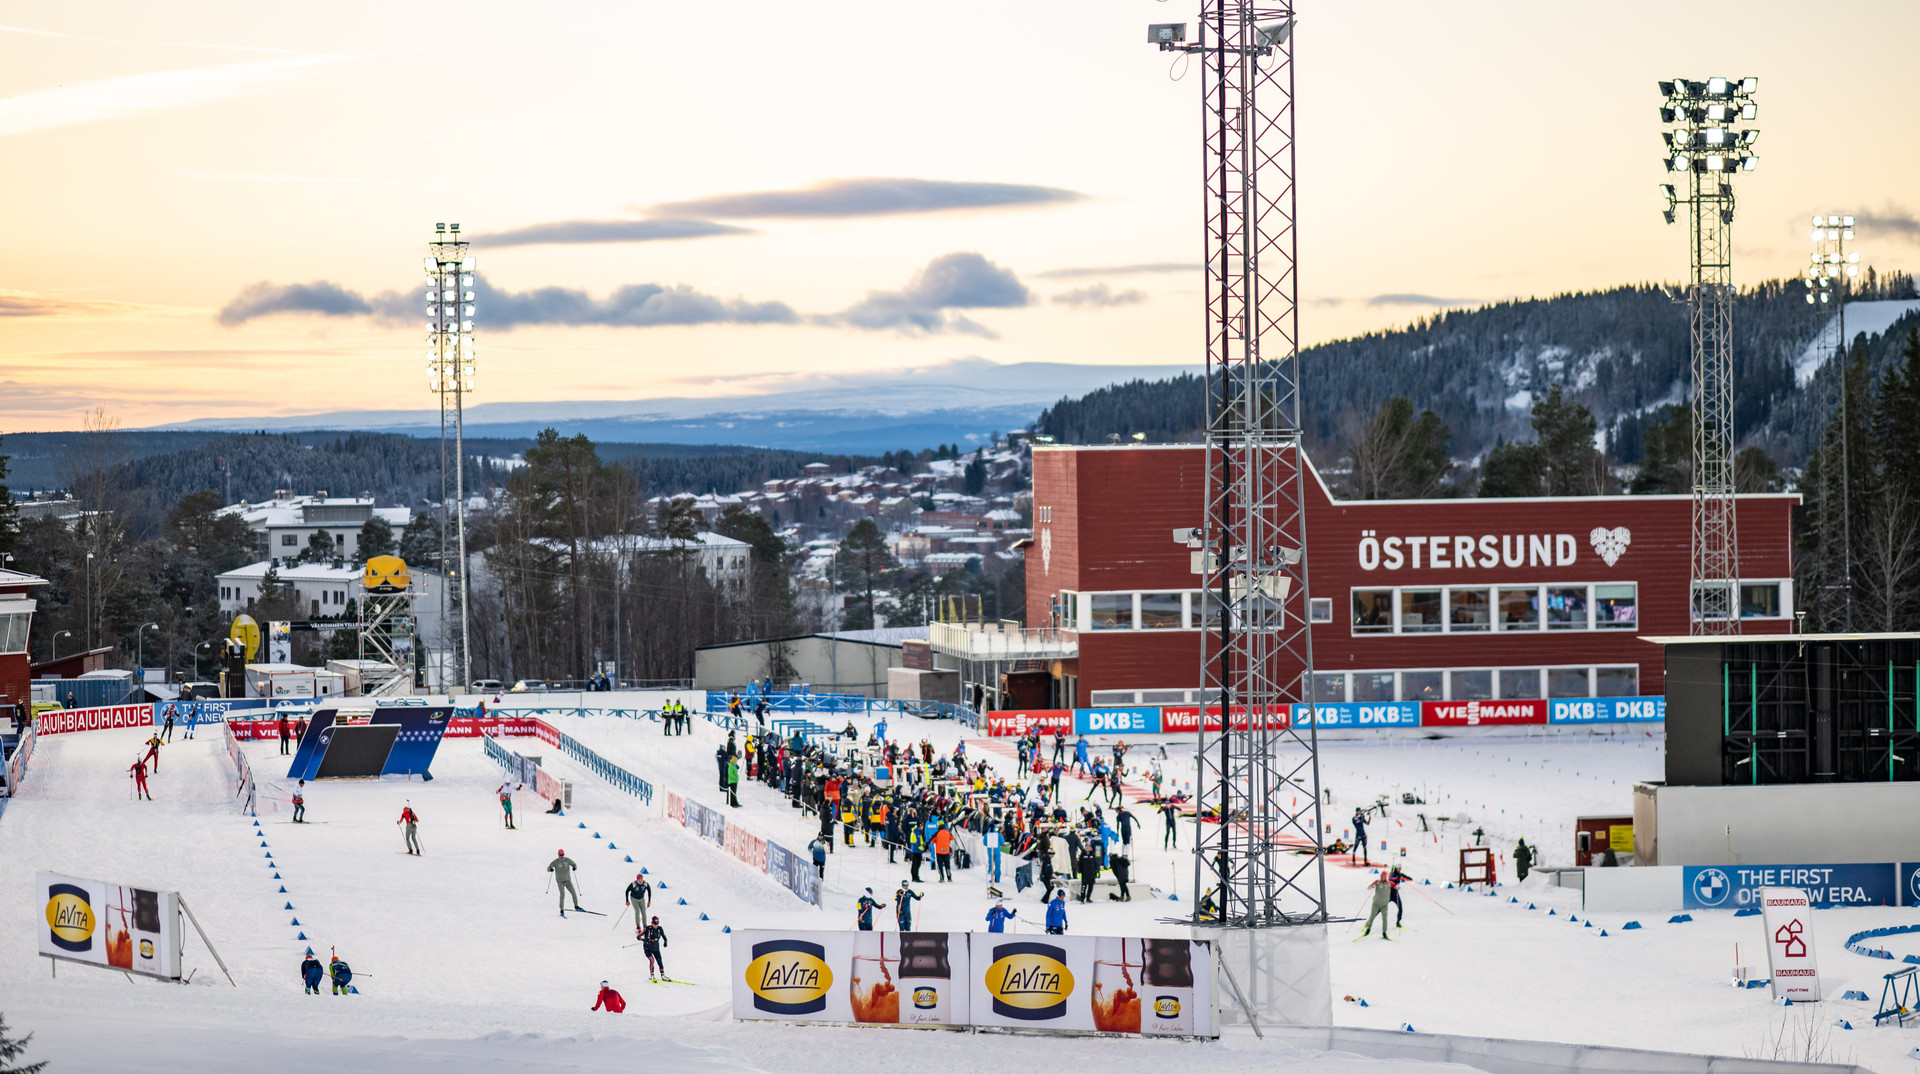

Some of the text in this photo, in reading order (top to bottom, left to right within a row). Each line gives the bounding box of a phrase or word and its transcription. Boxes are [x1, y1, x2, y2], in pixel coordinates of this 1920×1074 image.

[1358, 530, 1577, 571] ÖSTERSUND
[203, 702, 232, 712] FIRST
[1359, 706, 1400, 723] DKB
[1434, 701, 1534, 725] VIESSMANN
[1555, 702, 1595, 720] DKB
[1615, 701, 1656, 719] DKB
[66, 706, 152, 732] BAUHAUS
[196, 713, 204, 723] A
[1089, 713, 1131, 730] DKB
[1297, 707, 1339, 725] DKB
[1698, 870, 1725, 882] BMW
[1737, 868, 1833, 885] THE FIRST
[1766, 898, 1807, 907] BAUHAUS
[1829, 886, 1872, 903] ERA.
[1775, 968, 1816, 978] BAUHAUS
